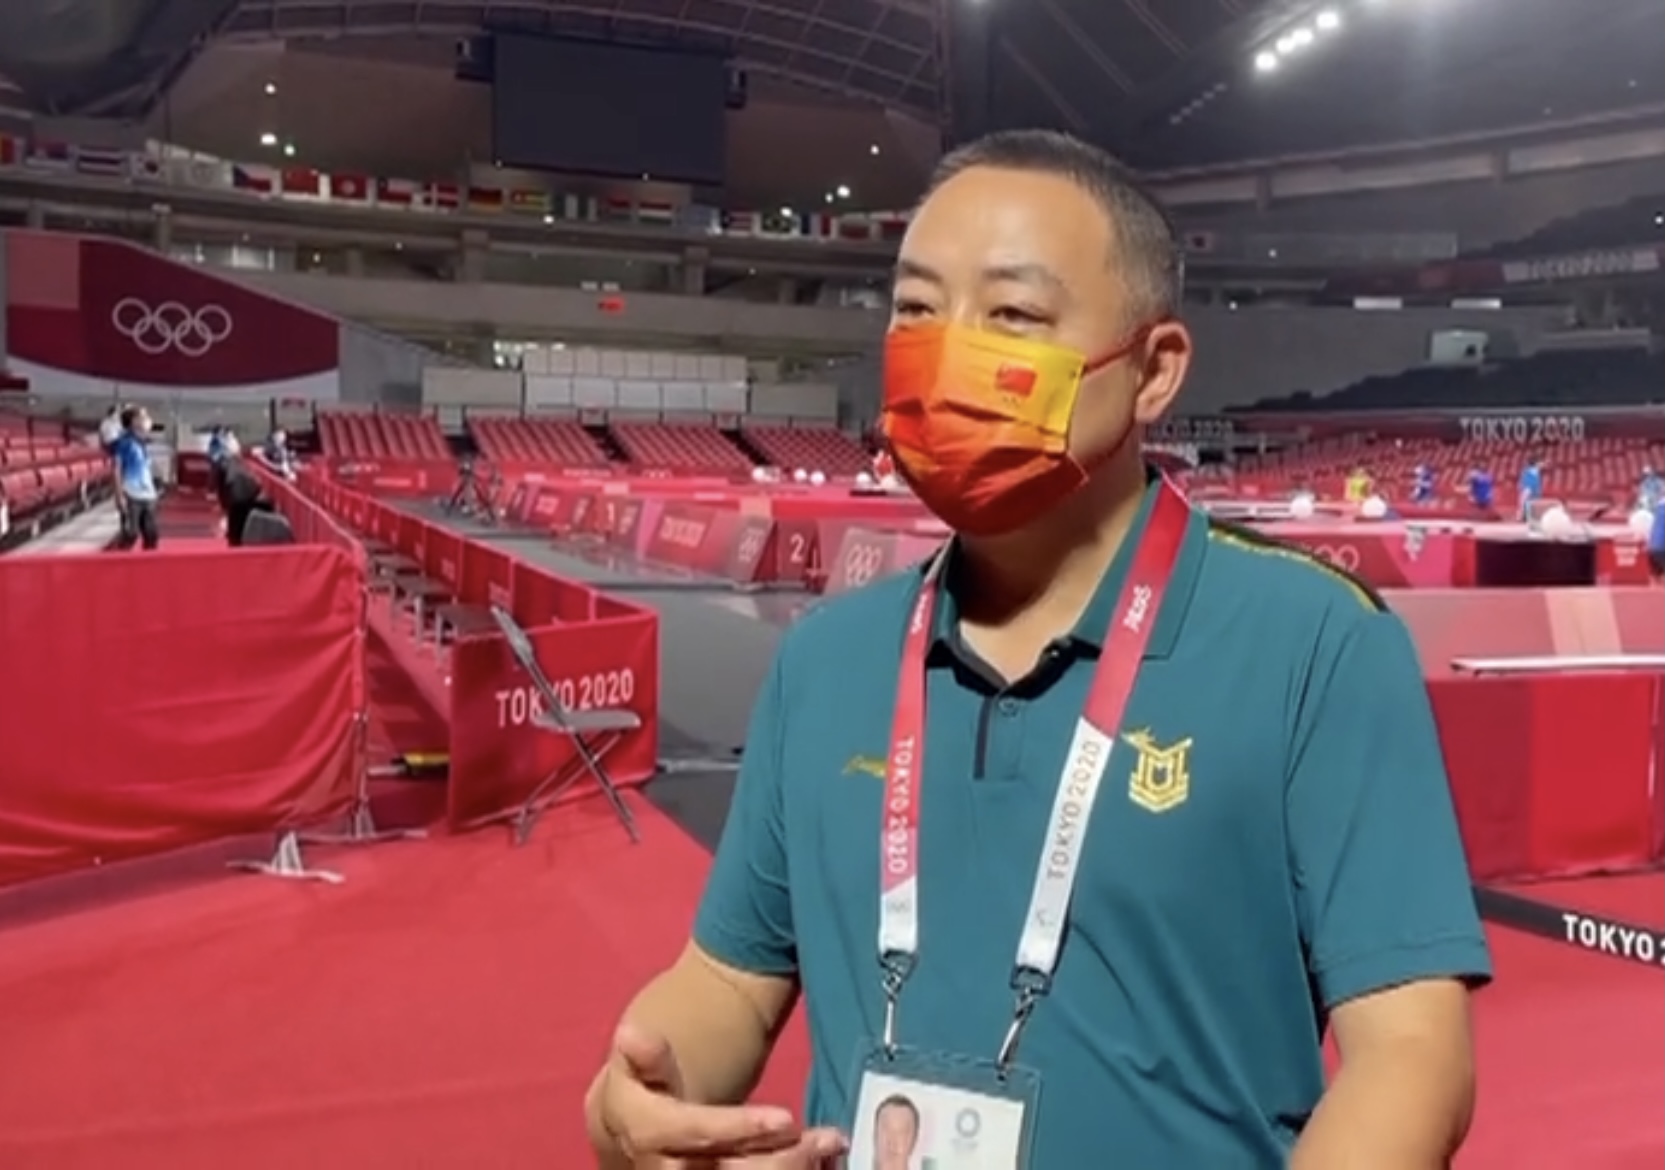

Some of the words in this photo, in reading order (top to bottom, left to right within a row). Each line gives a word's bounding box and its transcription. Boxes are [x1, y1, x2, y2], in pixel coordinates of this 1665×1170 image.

[1459, 416, 1527, 442] TOKYO
[1530, 416, 1585, 441] 2020
[789, 533, 805, 563] 2
[579, 667, 634, 710] 2020
[890, 735, 915, 812] TOKYO
[1046, 801, 1082, 880] TOKYO
[1066, 740, 1101, 796] 2020
[887, 814, 909, 874] 2020
[1562, 913, 1655, 962] TOKYO
